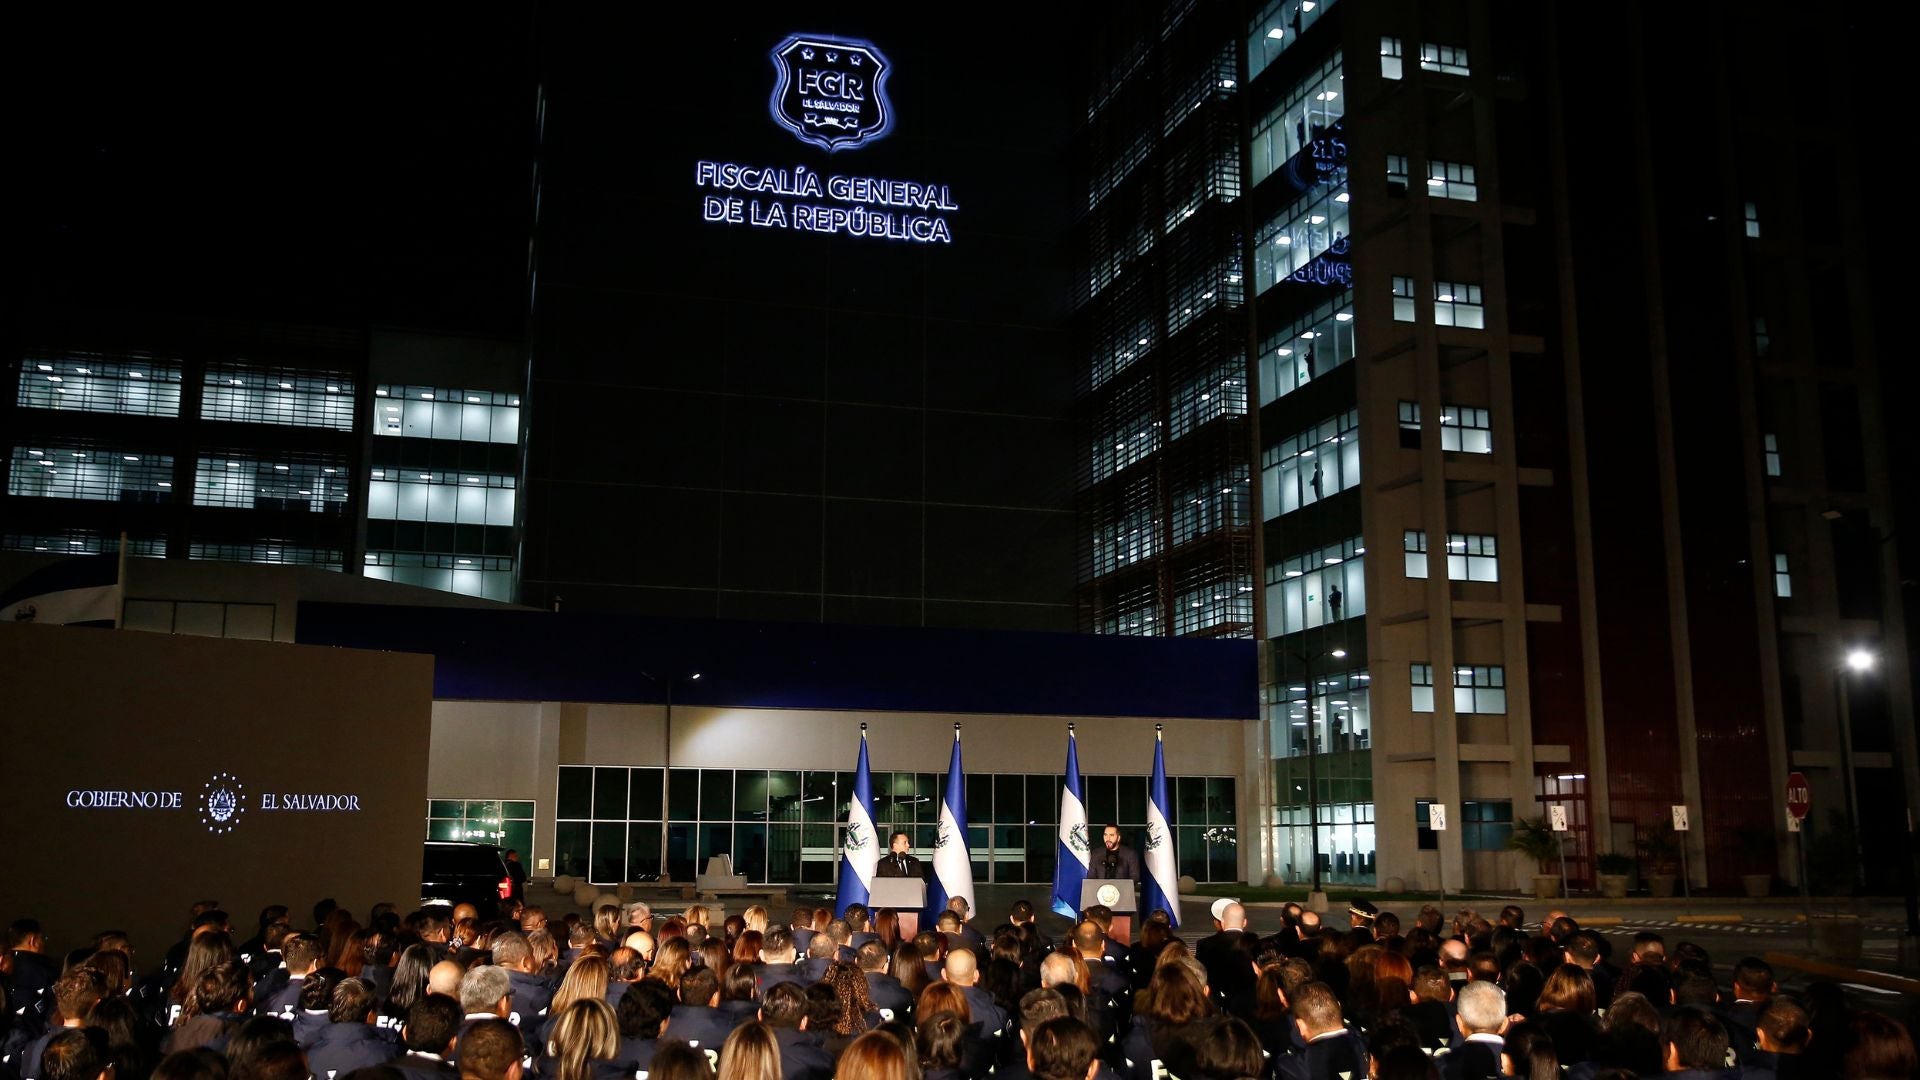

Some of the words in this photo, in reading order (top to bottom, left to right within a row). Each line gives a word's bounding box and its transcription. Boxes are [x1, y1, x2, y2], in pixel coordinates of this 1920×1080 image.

[798, 67, 865, 101] FGR
[802, 98, 814, 109] EL
[814, 99, 861, 114] SALVADOR
[696, 160, 824, 198] FISCALÍA
[828, 175, 959, 211] GENERAL
[704, 196, 745, 224] DE
[750, 200, 788, 228] LA
[793, 205, 951, 243] REPÚBLICA
[66, 790, 158, 808] GOBIERNO
[160, 792, 183, 808] DE
[261, 794, 279, 810] EL
[283, 794, 361, 811] SALVADOR
[1788, 787, 1808, 804] ALTO
